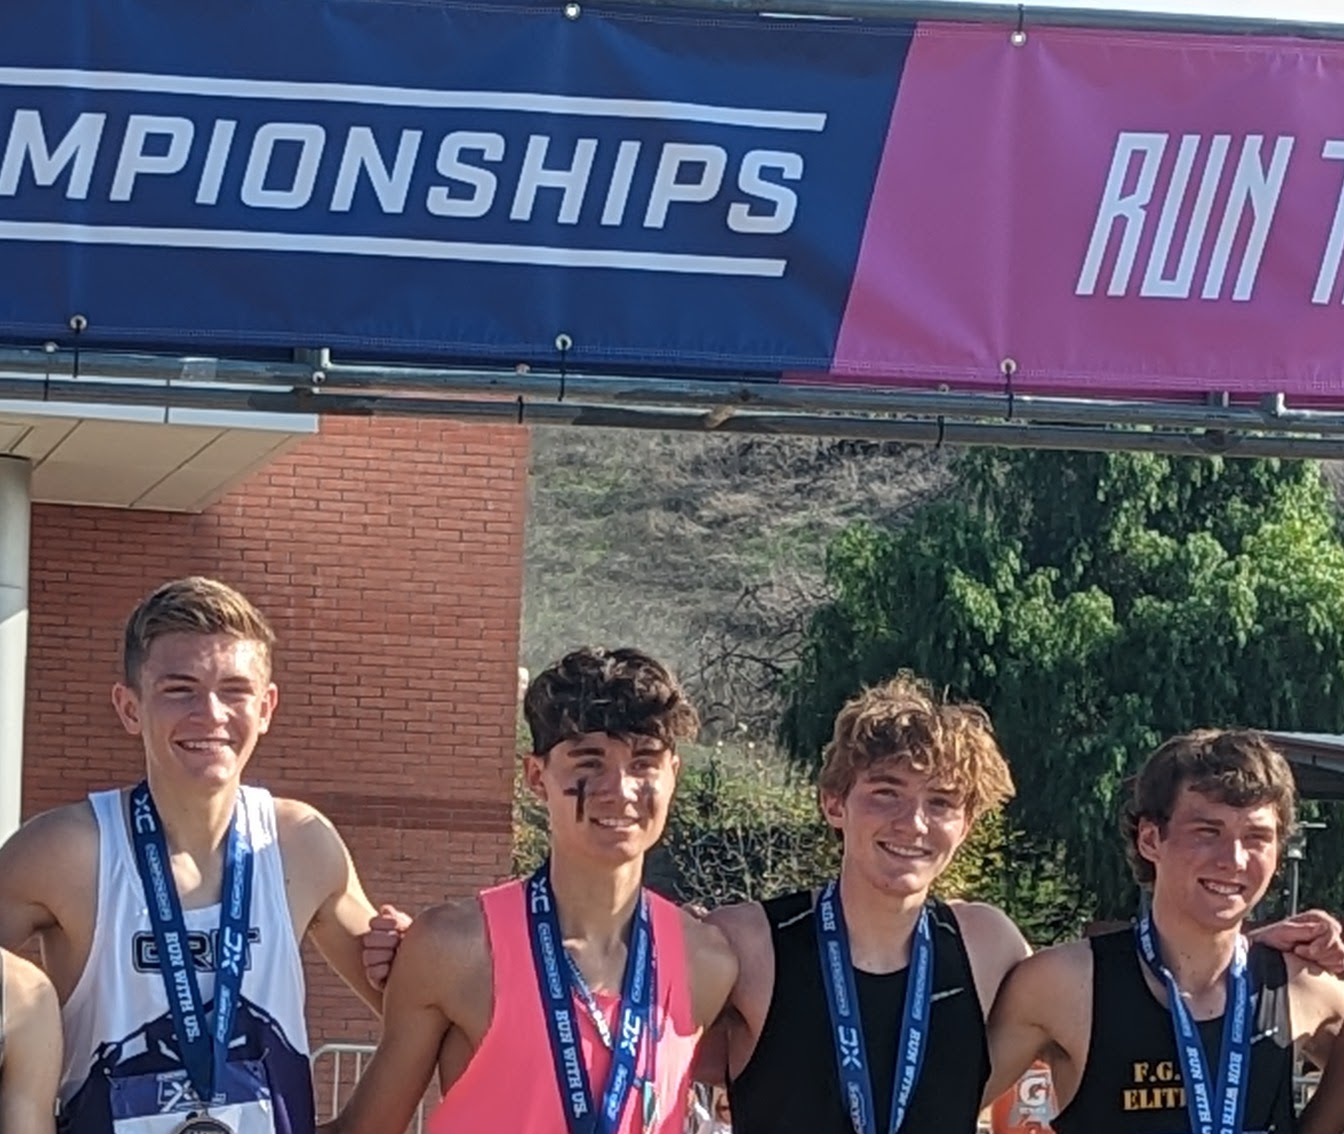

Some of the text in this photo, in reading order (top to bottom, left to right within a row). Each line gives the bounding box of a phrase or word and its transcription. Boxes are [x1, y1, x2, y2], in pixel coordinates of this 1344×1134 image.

[1075, 131, 1295, 302] RUN
[164, 931, 185, 967] RUN
[174, 969, 194, 1013] WITH
[555, 1010, 574, 1044] RUN
[906, 1027, 921, 1064] RUN
[563, 1046, 582, 1089] WITH
[1186, 1046, 1203, 1080] RUN
[1228, 1051, 1243, 1085] RUN
[1194, 1083, 1212, 1122] WITH
[1222, 1087, 1238, 1126] WITH
